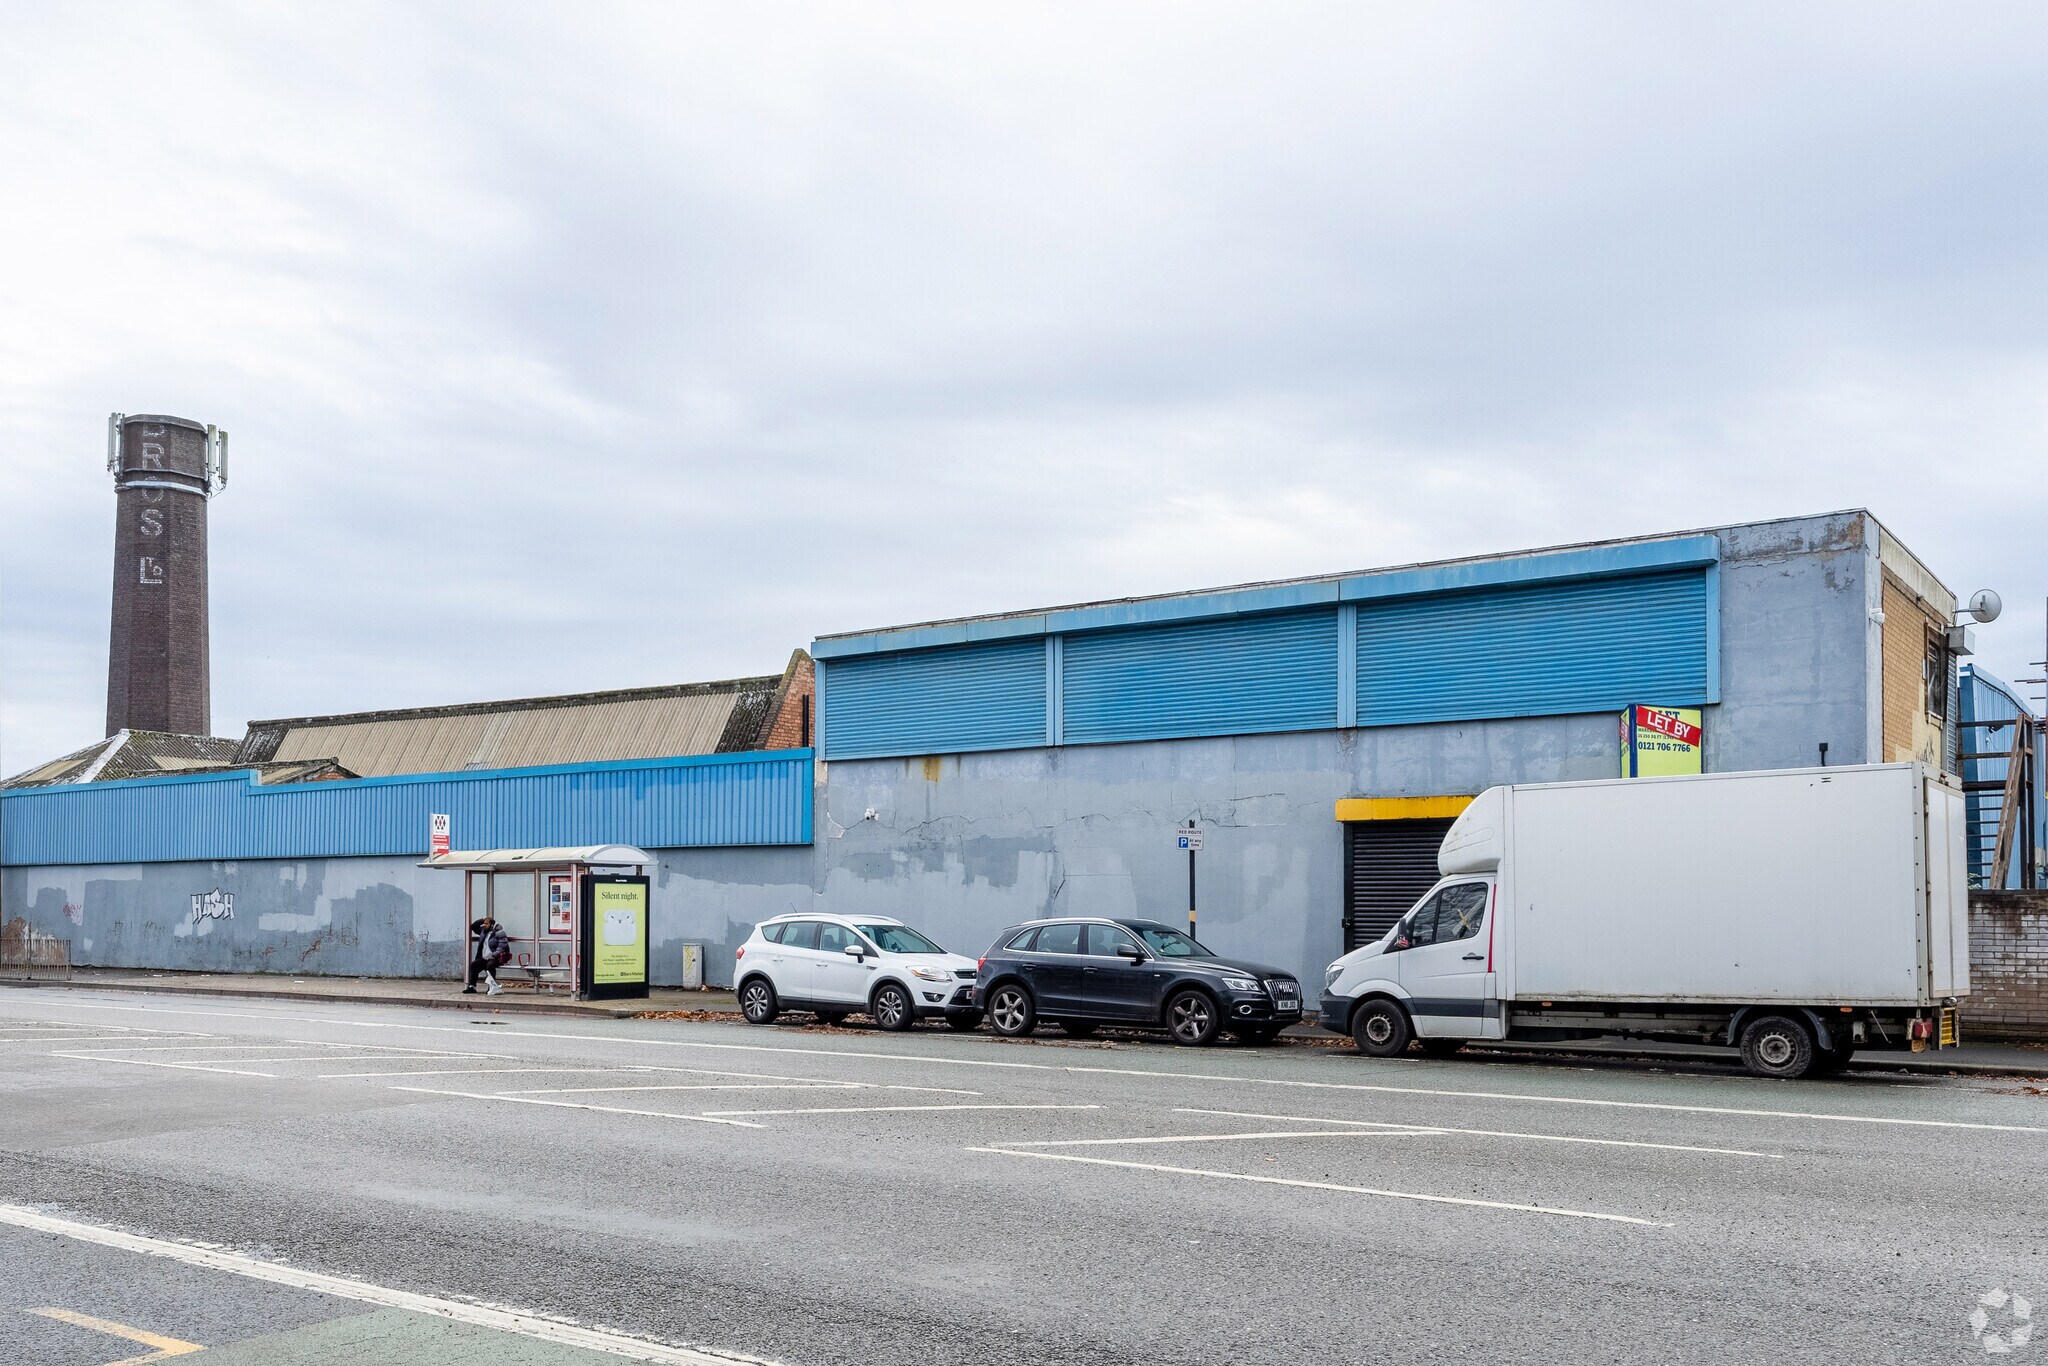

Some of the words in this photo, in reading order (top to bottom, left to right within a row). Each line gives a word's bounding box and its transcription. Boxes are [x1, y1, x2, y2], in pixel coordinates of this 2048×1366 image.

[1647, 711, 1672, 731] LET
[1674, 721, 1691, 738] BY
[1638, 742, 1655, 750] 0121
[1657, 743, 1671, 751] 706
[1673, 744, 1691, 752] 7766
[1180, 838, 1187, 847] P
[601, 891, 620, 900] Silent
[621, 892, 639, 901] night.
[190, 887, 236, 925] HASH
